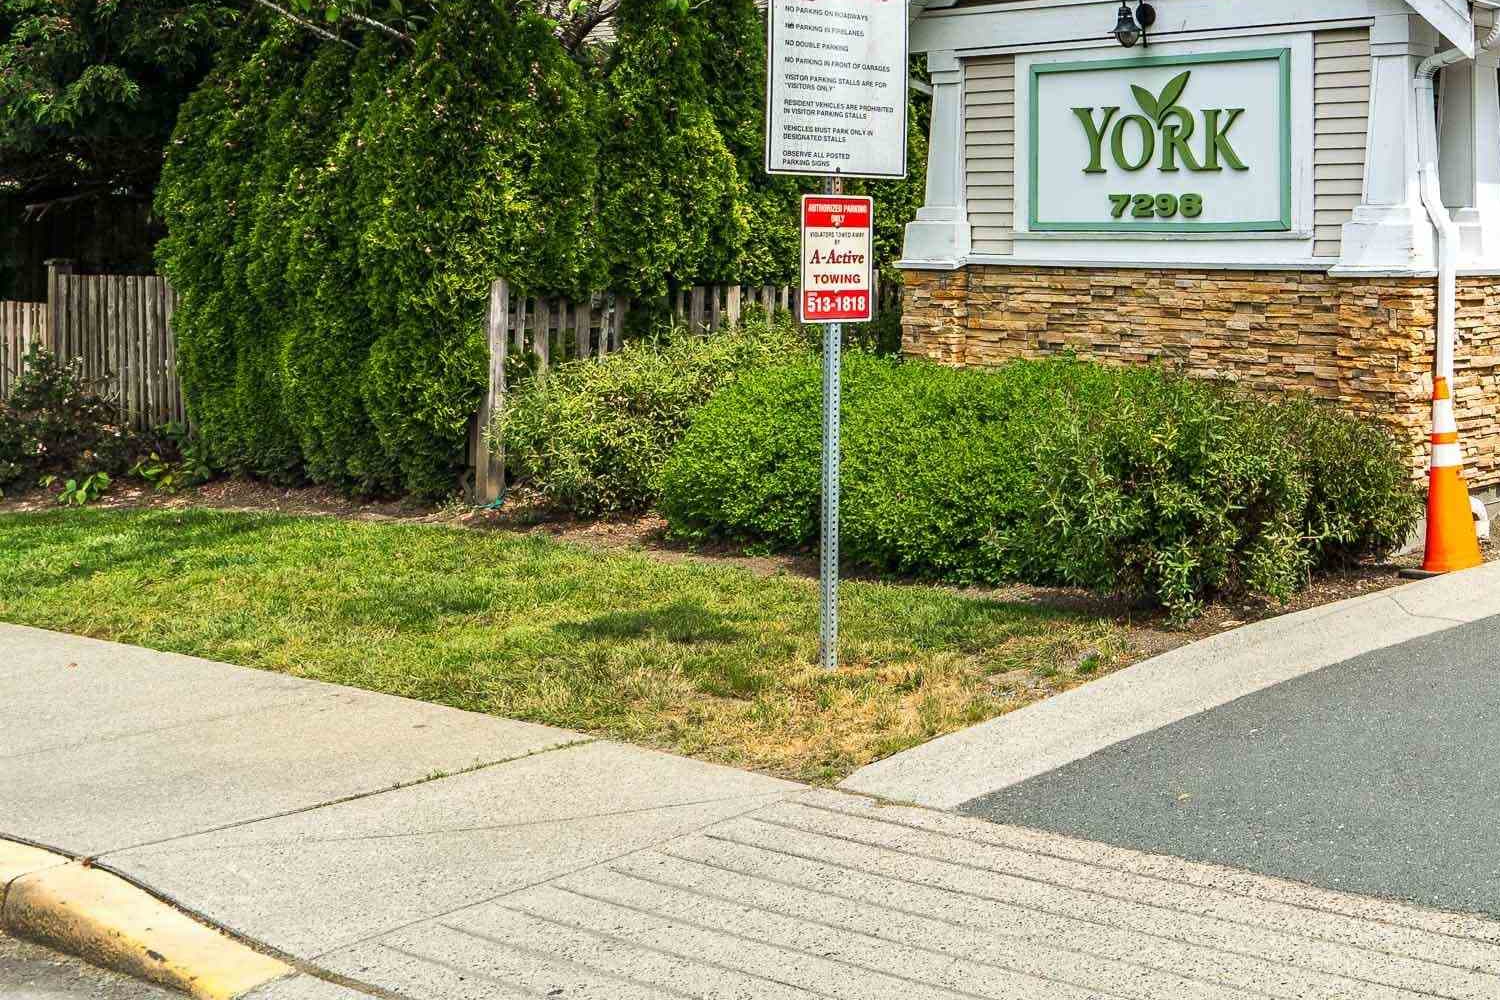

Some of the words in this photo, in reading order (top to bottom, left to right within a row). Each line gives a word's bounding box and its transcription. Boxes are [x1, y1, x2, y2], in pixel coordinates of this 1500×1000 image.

[784, 5, 795, 13] NO
[796, 7, 823, 16] PARKING
[784, 22, 795, 30] NO
[796, 23, 823, 33] PARKING
[796, 40, 821, 49] DOUBLE
[822, 43, 848, 52] PARKING
[796, 57, 823, 66] PARKING
[832, 60, 851, 69] FRONT
[862, 64, 890, 73] GARAGES
[784, 73, 809, 81] VISITOR
[810, 75, 837, 84] PARKING
[838, 78, 860, 87] STALLS
[861, 80, 875, 88] ARE
[875, 81, 887, 89] FOR
[784, 98, 814, 107] RESIDENT
[815, 101, 844, 110] VEHICLES
[845, 103, 858, 111] ARE
[859, 104, 894, 113] PROHIBITED
[792, 108, 816, 116] VISITOR
[816, 109, 844, 118] PARKING
[844, 111, 867, 120] STALLS
[783, 124, 814, 133] VEHICLES
[815, 126, 831, 134] MUST
[832, 127, 849, 135] PARK
[849, 128, 866, 136] ONLY
[783, 133, 822, 142] DESIGNATED
[823, 135, 847, 143] STALLS
[1070, 105, 1249, 174] YORK
[782, 150, 812, 158] OBSERVE
[813, 151, 825, 159] ALL
[826, 152, 850, 160] POSTED
[782, 158, 811, 167] PARKING
[811, 159, 830, 168] SIGNS
[1109, 194, 1203, 218] 7298
[809, 249, 864, 265] A-Active
[813, 273, 861, 285] TOWING
[807, 295, 865, 312] 513-1818
